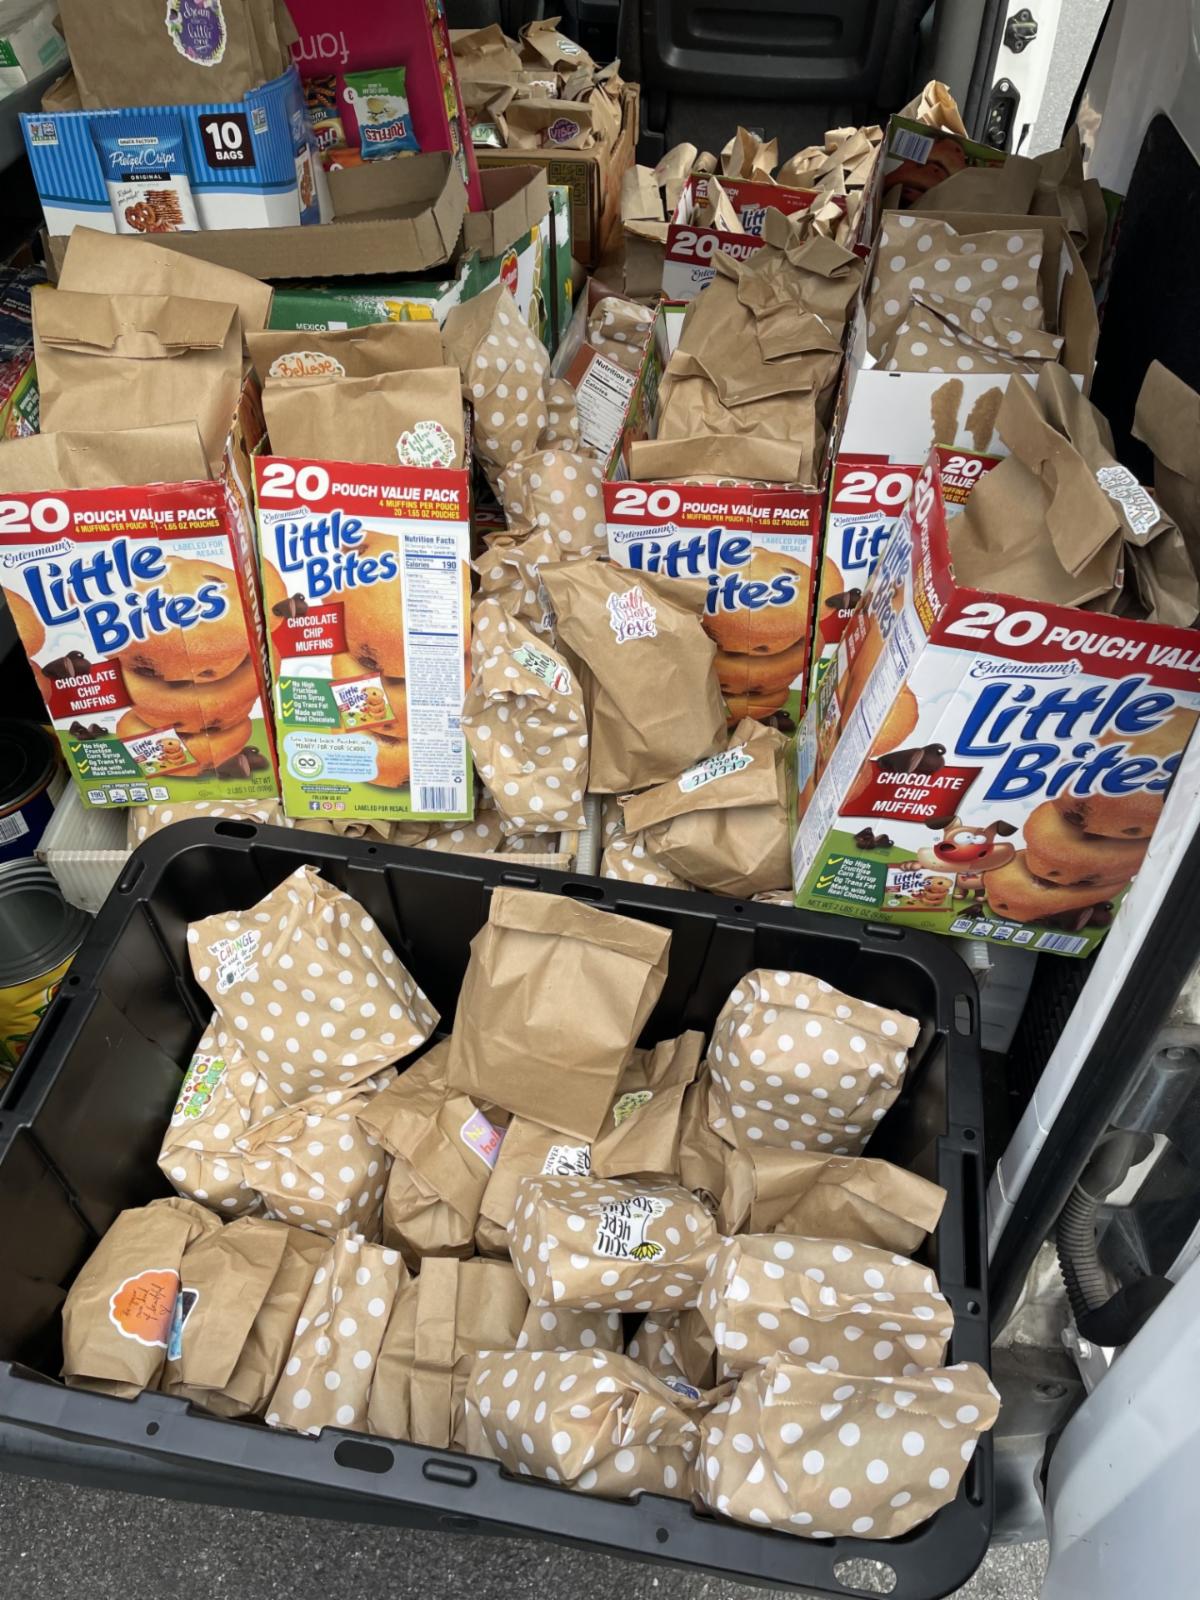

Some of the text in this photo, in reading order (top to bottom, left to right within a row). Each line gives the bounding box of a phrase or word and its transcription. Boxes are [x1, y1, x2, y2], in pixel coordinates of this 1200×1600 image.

[205, 122, 243, 149] 10
[365, 122, 405, 141] RUFFLES
[109, 149, 175, 171] Pretzel Crisps
[216, 151, 244, 160] BAGS
[671, 231, 760, 258] 20 POUC
[296, 323, 326, 331] MEXICO
[596, 359, 625, 382] Nutrition
[942, 456, 982, 477] 20
[261, 463, 459, 502] 20 POUCH VALUE PACK
[835, 471, 913, 506] 20
[940, 473, 973, 488] VALUE
[386, 501, 417, 509] MUFFINS
[436, 503, 459, 511] POUCH
[613, 488, 810, 519] 20 POUCH VALUE PACK
[0, 498, 217, 533] 20 POUCH VALUE PACK
[422, 510, 430, 518] OZ
[431, 510, 460, 519] POUCHES
[725, 515, 744, 523] POUCH
[781, 519, 809, 527] POUCHES
[81, 525, 110, 533] MUFFINS
[125, 522, 147, 530] POUCH
[179, 521, 188, 529] OZ
[190, 519, 219, 528] POUCHES
[613, 524, 679, 543] Entenmann's
[173, 540, 223, 551] LABELED FOR
[275, 511, 363, 572] Little
[404, 535, 434, 543] Nutrition
[762, 536, 807, 545] LABELED FOR
[842, 525, 891, 570] Lit
[915, 466, 934, 524] 20
[925, 583, 942, 614] PACK
[628, 528, 752, 578] Little
[306, 553, 397, 598] Bites
[441, 562, 456, 570] 190
[23, 539, 168, 627] Little
[706, 574, 796, 614] ites
[84, 584, 227, 653] Bites
[287, 614, 337, 629] CHOCOLATE
[303, 628, 323, 638] CHIP
[944, 602, 1047, 647] 20
[1042, 626, 1146, 661] POUCH
[296, 638, 333, 652] MUFFINS
[970, 658, 1081, 680] Entenmann's
[55, 669, 117, 690] CHOCOLATE
[77, 685, 101, 698] CHIP
[70, 694, 117, 711] MUFFINS
[954, 677, 1175, 757] Little
[692, 760, 746, 786] CREATE
[876, 772, 965, 790] CHOCOLATE
[982, 742, 1184, 801] Bites
[894, 787, 929, 799] CHIP
[872, 800, 937, 816] MUFFINS
[855, 860, 871, 869] High
[831, 883, 849, 891] Made
[844, 878, 863, 887] Trans
[855, 873, 877, 883] Syrup
[893, 872, 922, 885] Little
[901, 878, 932, 890] Bites
[844, 891, 877, 903] Chocolate
[220, 934, 256, 961] CHANGE
[602, 1213, 631, 1241] HERE
[145, 1283, 166, 1315] beautiful
